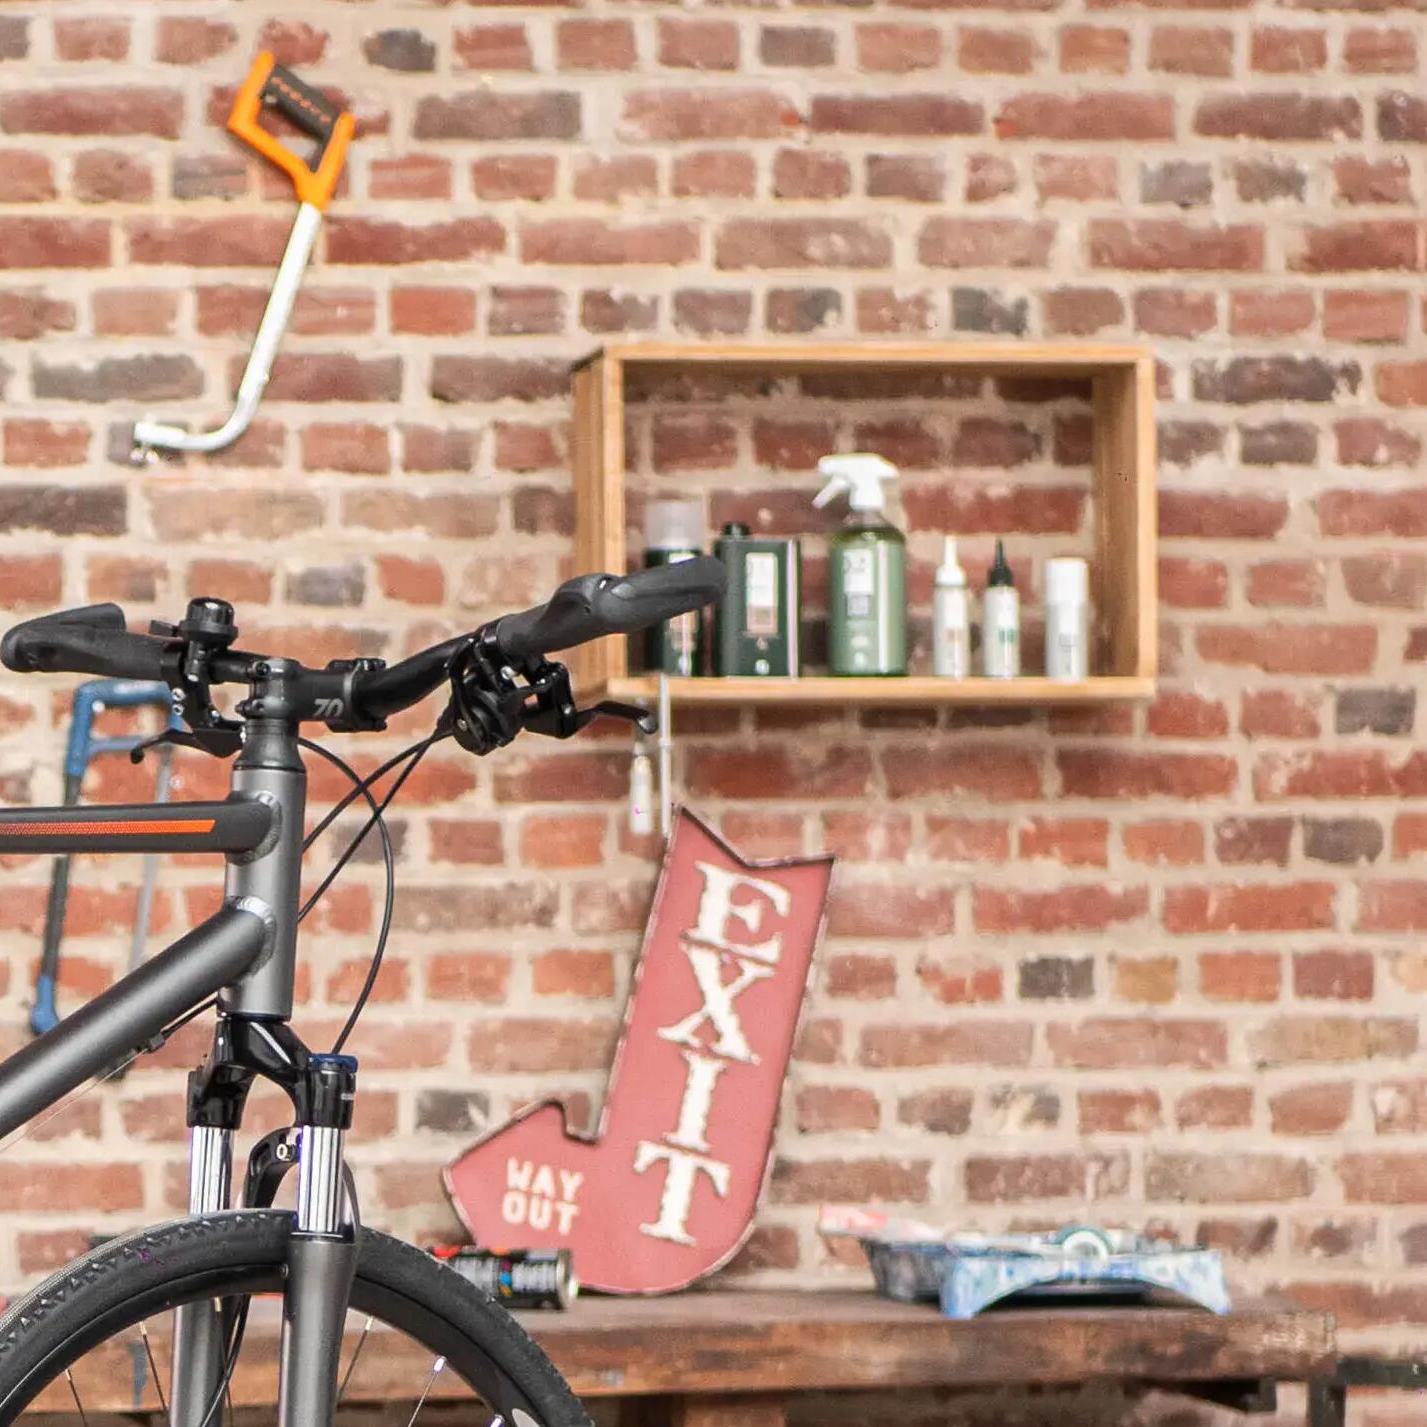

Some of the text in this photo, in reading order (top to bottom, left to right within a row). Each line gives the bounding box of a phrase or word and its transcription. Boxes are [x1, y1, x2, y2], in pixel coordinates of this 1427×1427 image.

[633, 860, 791, 1246] EXIT
[506, 1157, 584, 1202] WAY
[503, 1191, 578, 1235] OUT
